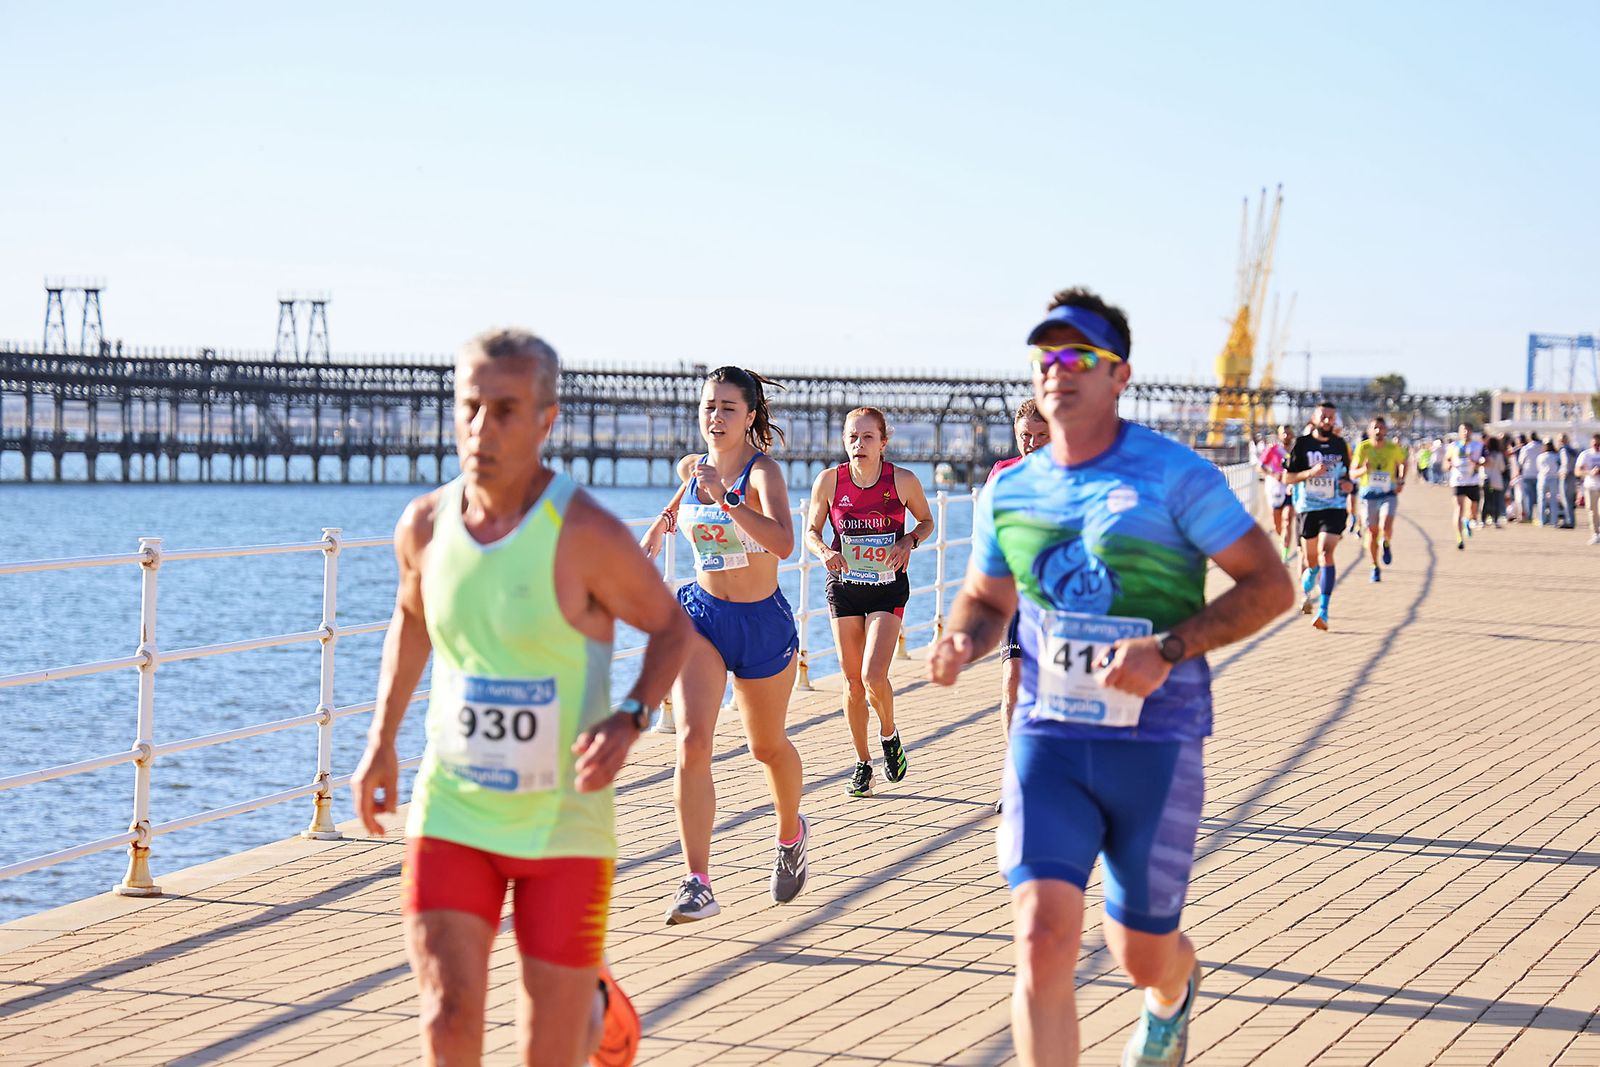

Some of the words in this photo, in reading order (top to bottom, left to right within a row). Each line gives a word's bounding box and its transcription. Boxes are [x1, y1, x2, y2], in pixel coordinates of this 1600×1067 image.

[838, 517, 891, 530] SOBERBIO
[852, 545, 887, 562] 149
[1053, 641, 1114, 674] 41
[458, 705, 538, 742] 930
